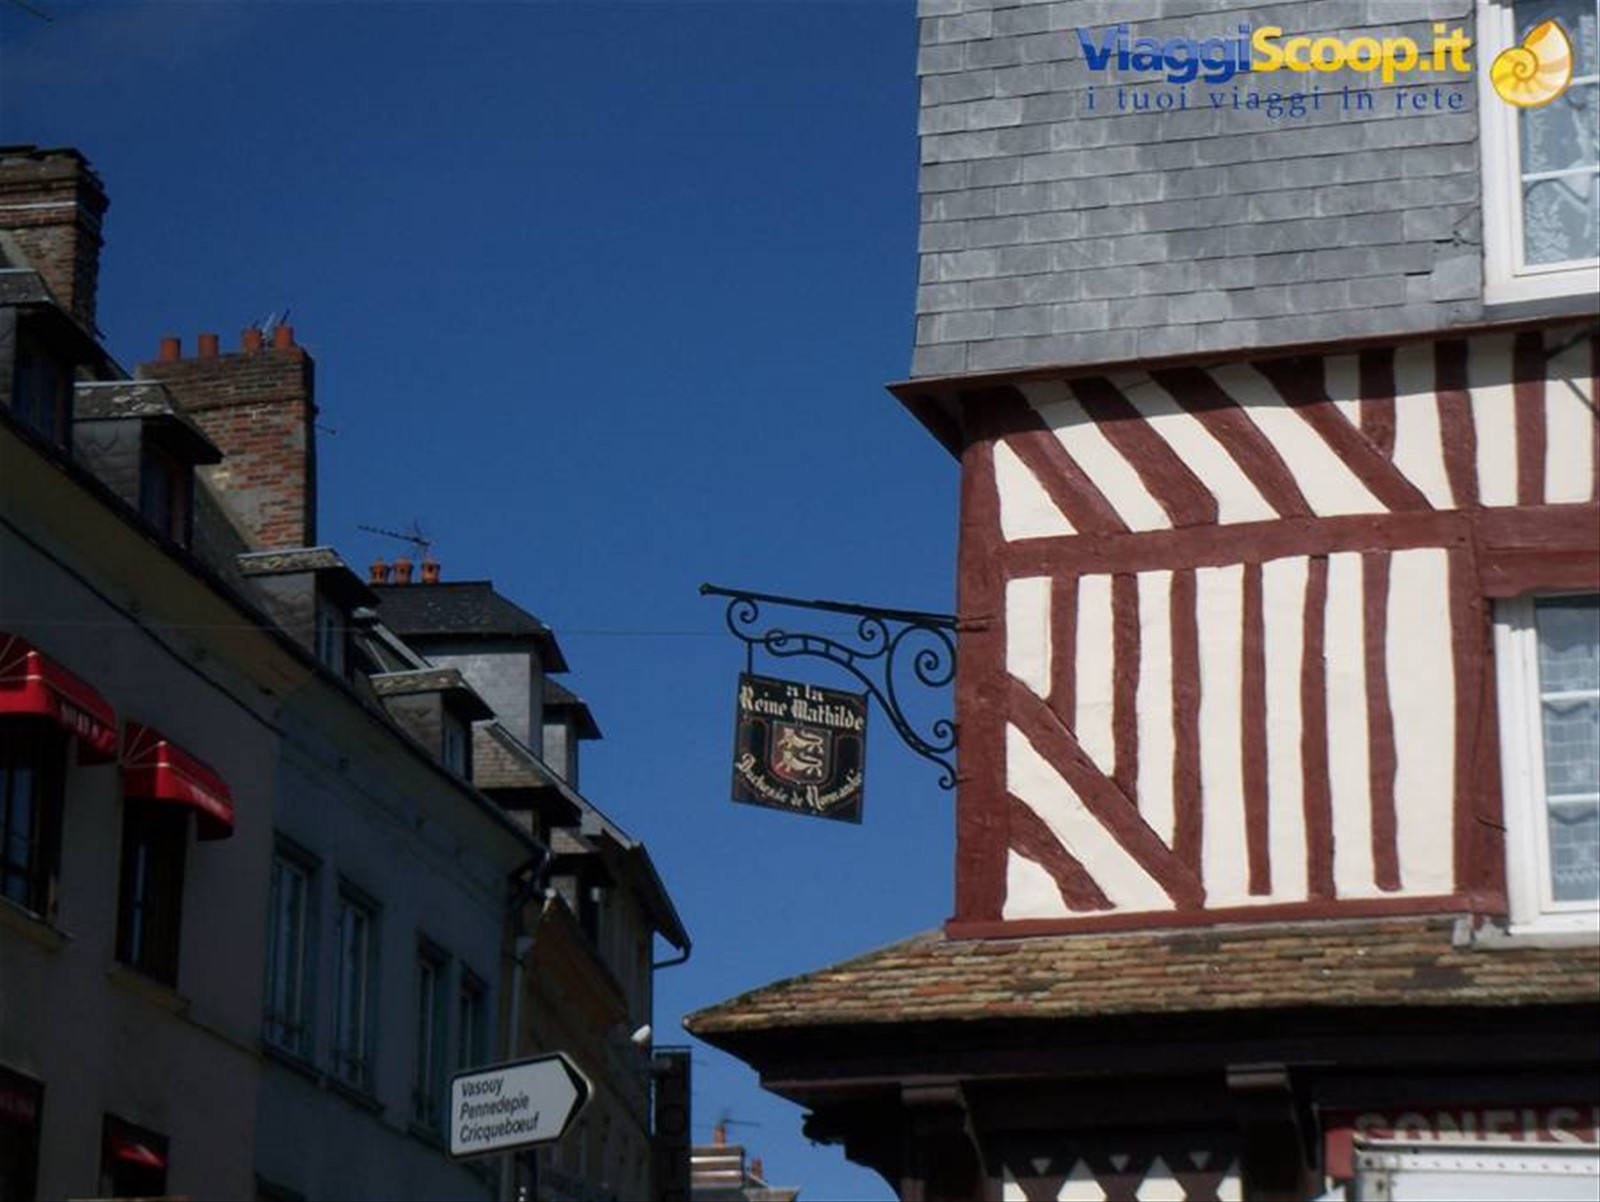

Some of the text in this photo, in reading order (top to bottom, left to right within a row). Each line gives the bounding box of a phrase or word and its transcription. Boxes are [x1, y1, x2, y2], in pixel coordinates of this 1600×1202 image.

[739, 685, 864, 730] Reine Mathilde
[461, 1076, 505, 1097] Vasouy
[460, 1091, 529, 1120] Pennedepie
[1353, 1107, 1600, 1144] CONFIS
